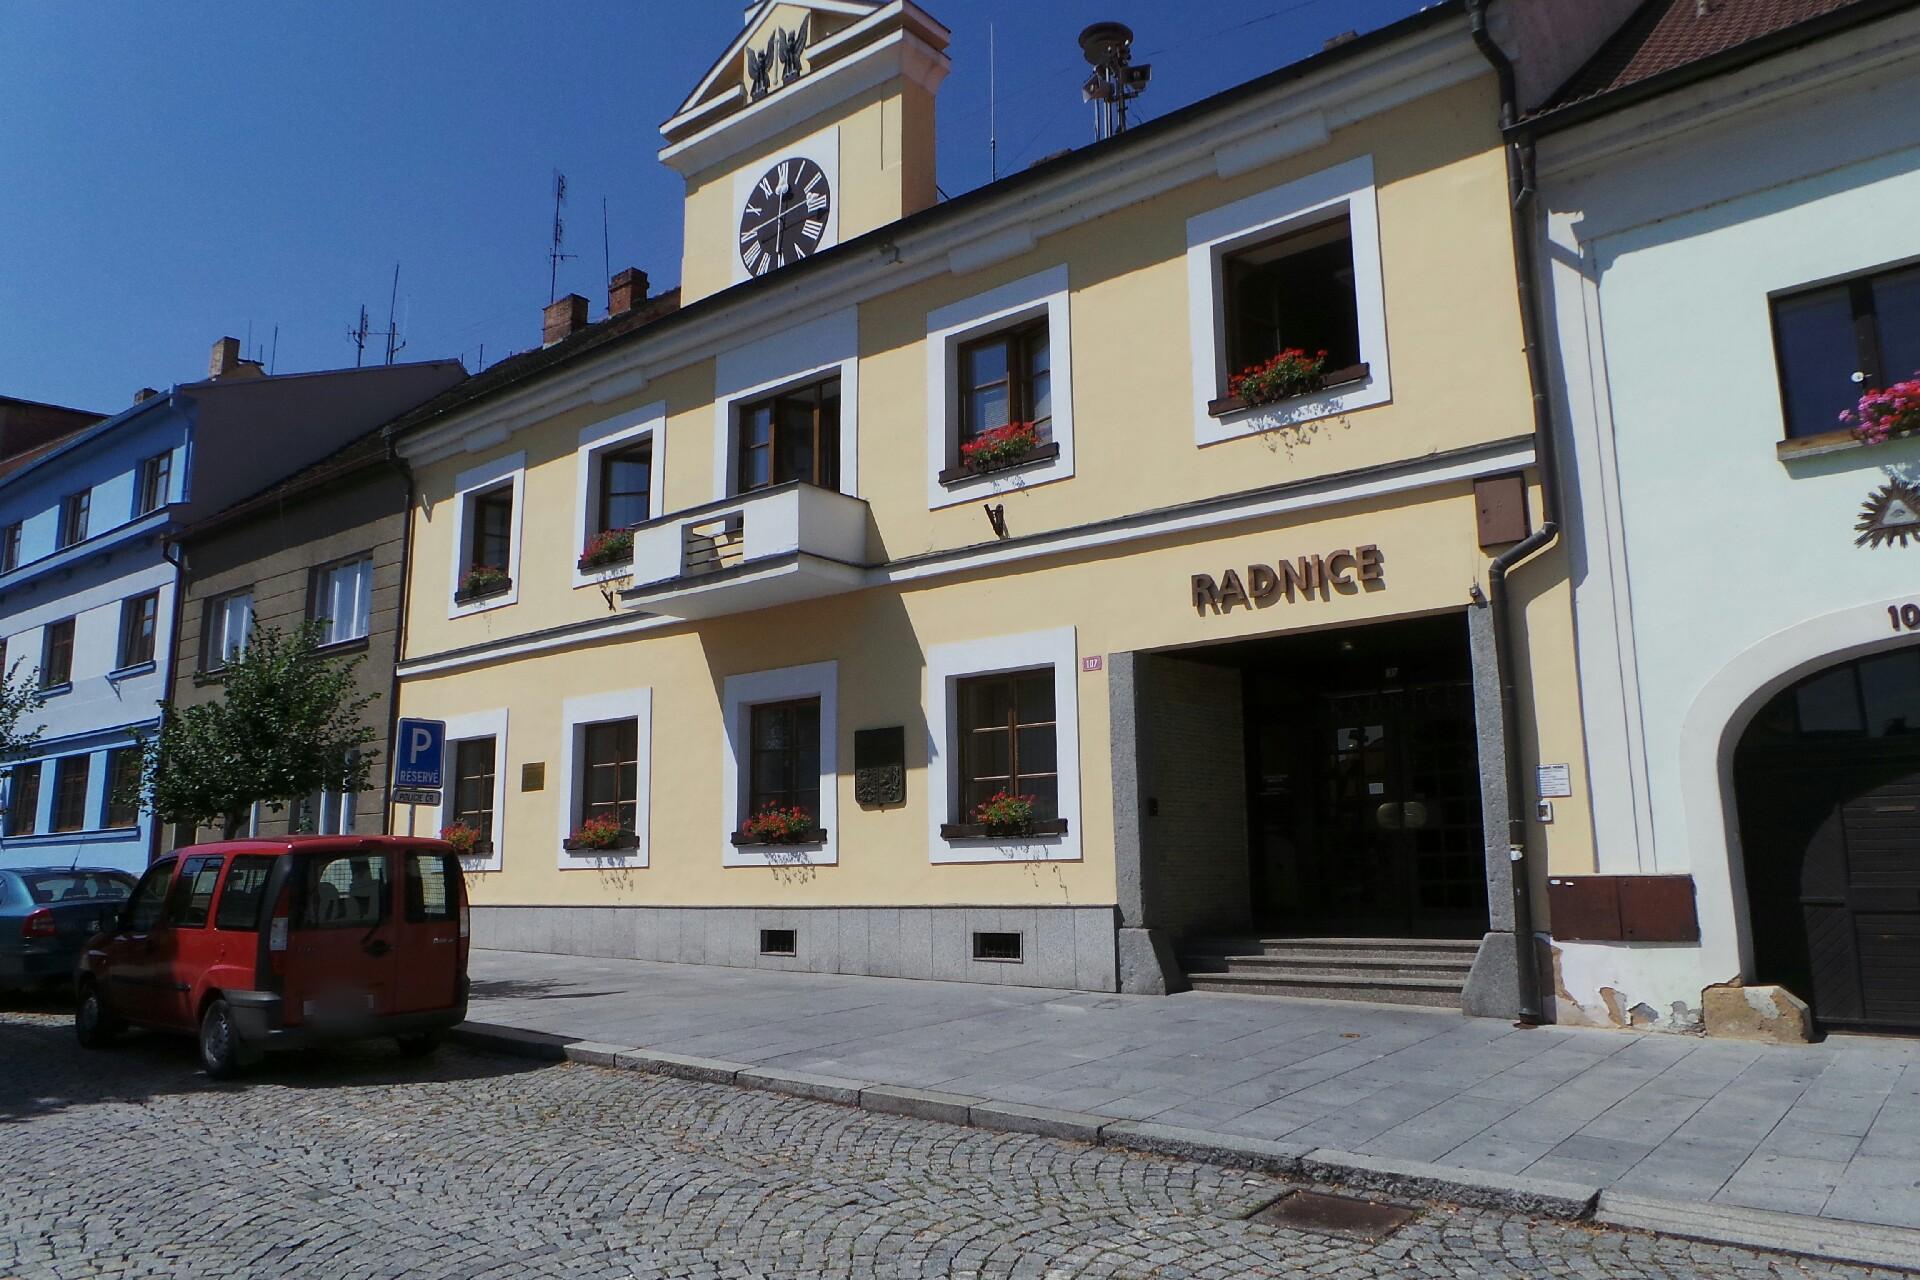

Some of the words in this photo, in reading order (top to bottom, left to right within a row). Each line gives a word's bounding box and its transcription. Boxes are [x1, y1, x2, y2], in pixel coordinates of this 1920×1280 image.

[1191, 544, 1378, 608] RADNICE
[1887, 603, 1920, 631] 10
[1086, 658, 1098, 669] 107
[410, 727, 432, 764] P
[399, 792, 424, 802] POLICIE
